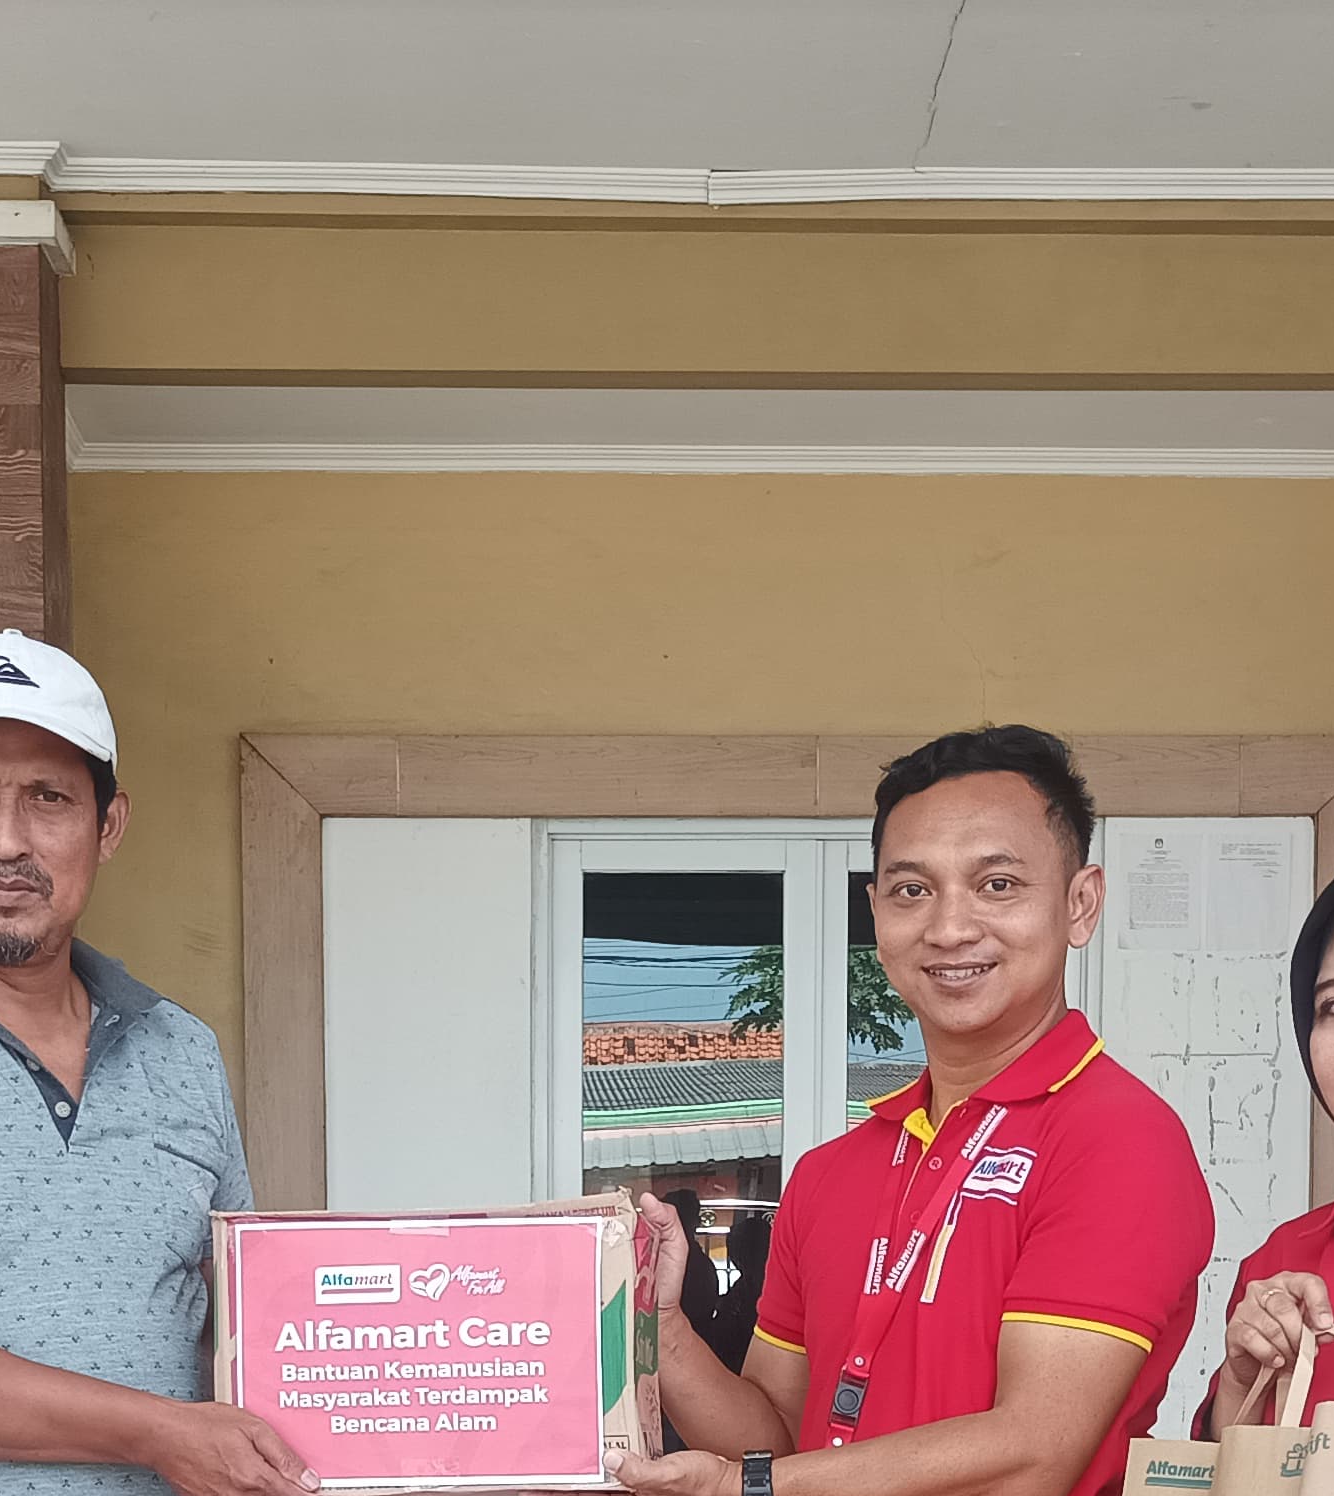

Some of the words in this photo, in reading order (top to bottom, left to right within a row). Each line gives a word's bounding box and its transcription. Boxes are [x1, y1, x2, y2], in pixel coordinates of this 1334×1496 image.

[960, 1104, 1001, 1160] Alfamart
[885, 1229, 921, 1289] Alfamart
[321, 1273, 393, 1286] Alfamart
[275, 1319, 450, 1352] Alfamart
[458, 1317, 551, 1347] Care
[281, 1363, 378, 1382] Bantuan
[384, 1357, 545, 1379] Kemanusiaan
[278, 1388, 411, 1412] Masyarakat
[415, 1384, 549, 1407] Terdampak
[330, 1415, 430, 1434] Bencana
[435, 1412, 497, 1430] Alam
[1147, 1460, 1215, 1478] Alfamart
